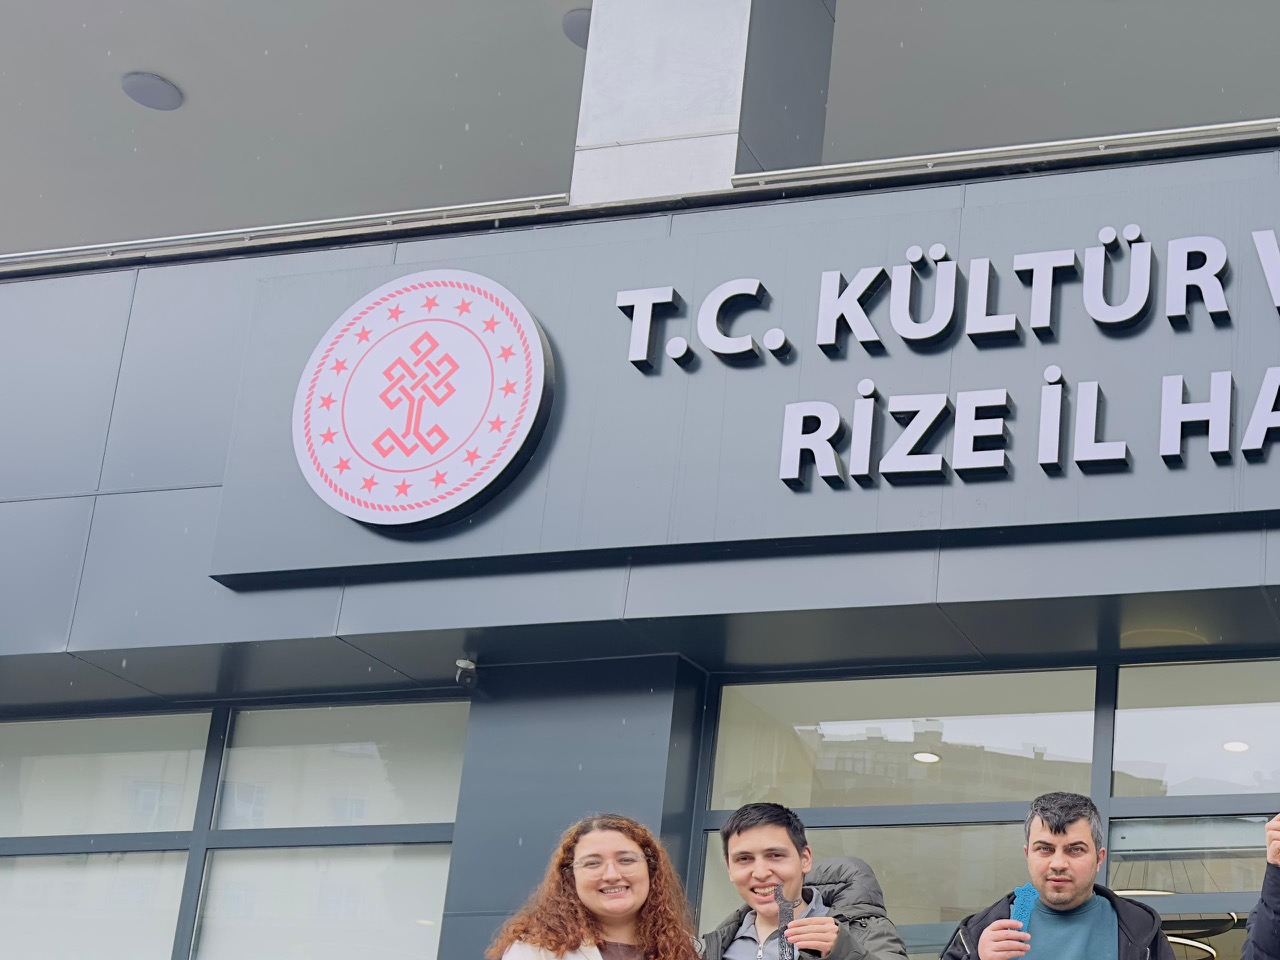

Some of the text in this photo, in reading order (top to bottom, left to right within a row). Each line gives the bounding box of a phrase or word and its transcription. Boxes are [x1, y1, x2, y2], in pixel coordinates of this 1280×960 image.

[616, 278, 785, 362] T.C.
[815, 223, 1229, 345] KÜLTÜR
[780, 378, 1007, 479] RİZE
[1037, 364, 1127, 464] İL
